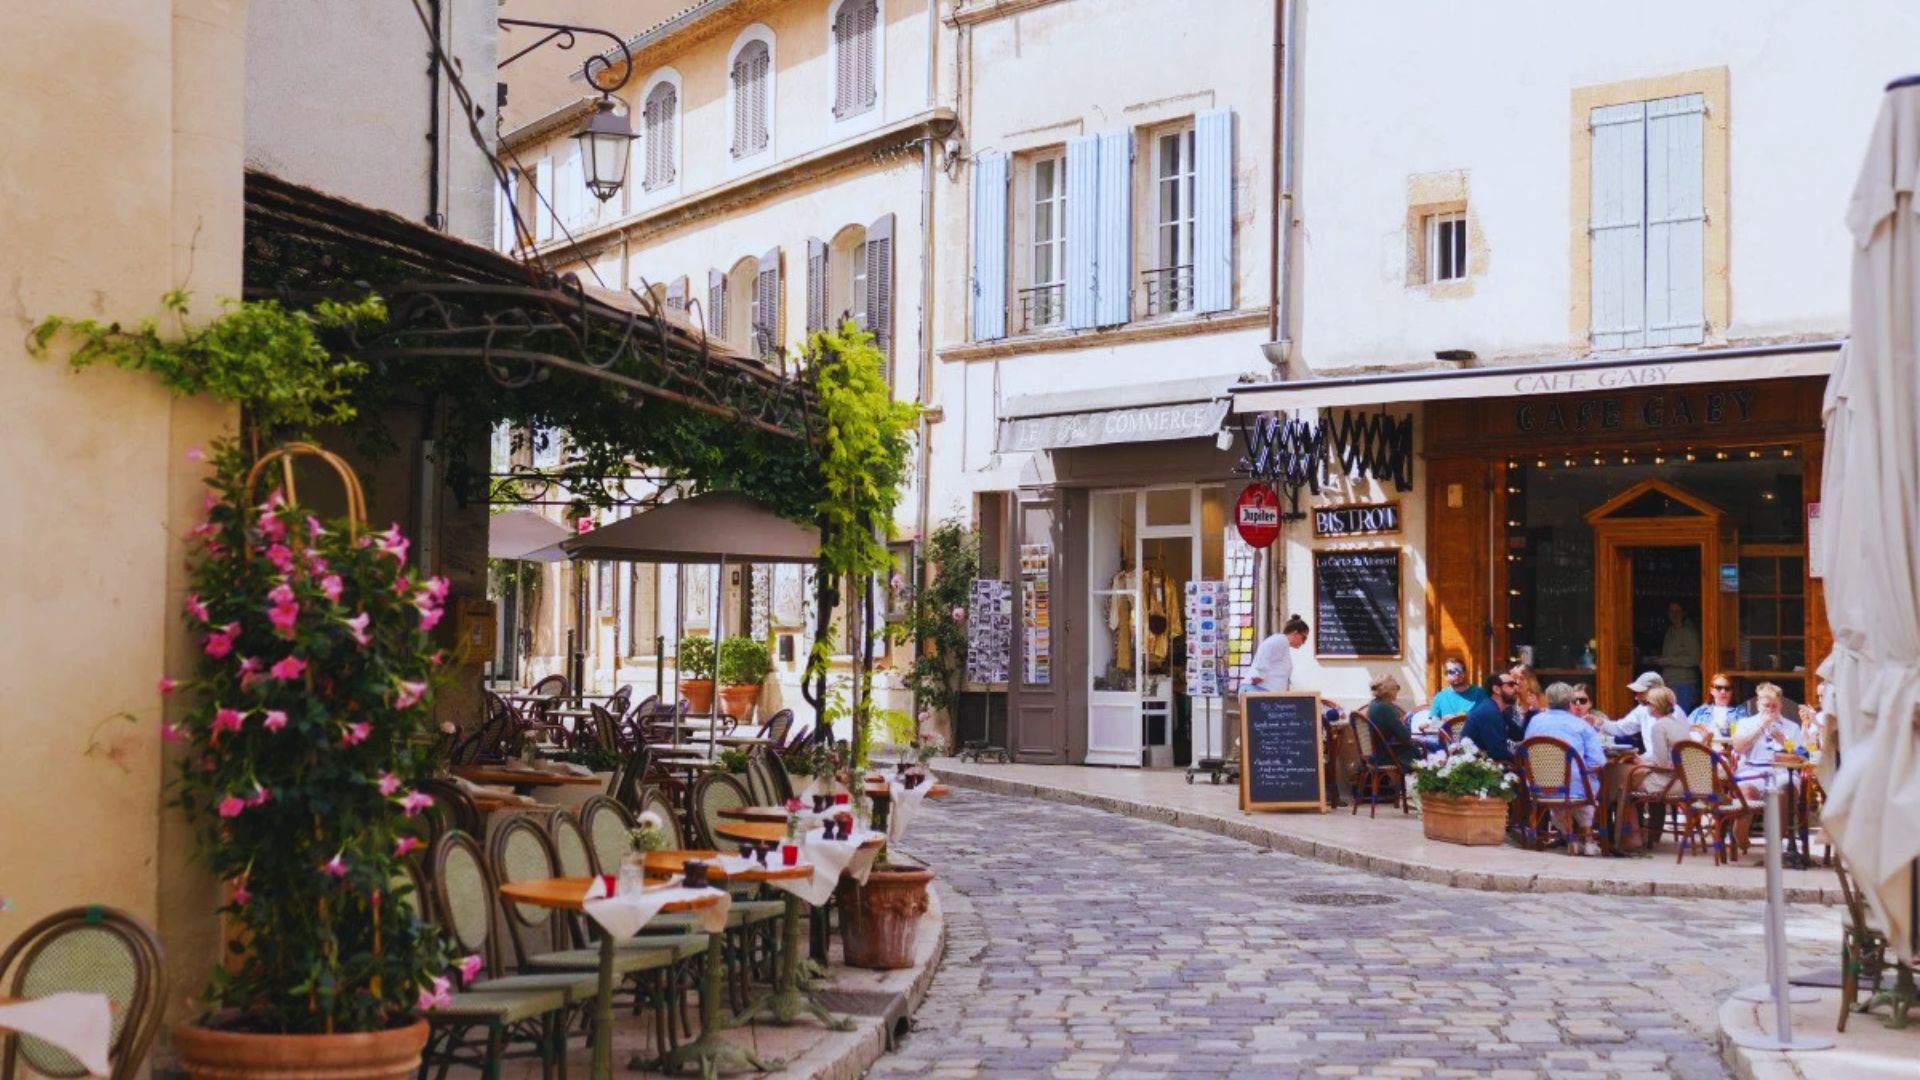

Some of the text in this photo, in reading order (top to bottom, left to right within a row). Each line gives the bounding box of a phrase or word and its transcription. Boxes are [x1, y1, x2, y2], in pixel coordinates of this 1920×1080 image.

[1598, 366, 1674, 387] GABY
[1105, 408, 1205, 433] COMMERCE
[1515, 391, 1755, 431] CAFE GABY
[1243, 508, 1276, 524] Jupiler
[1316, 506, 1397, 533] BISTROT
